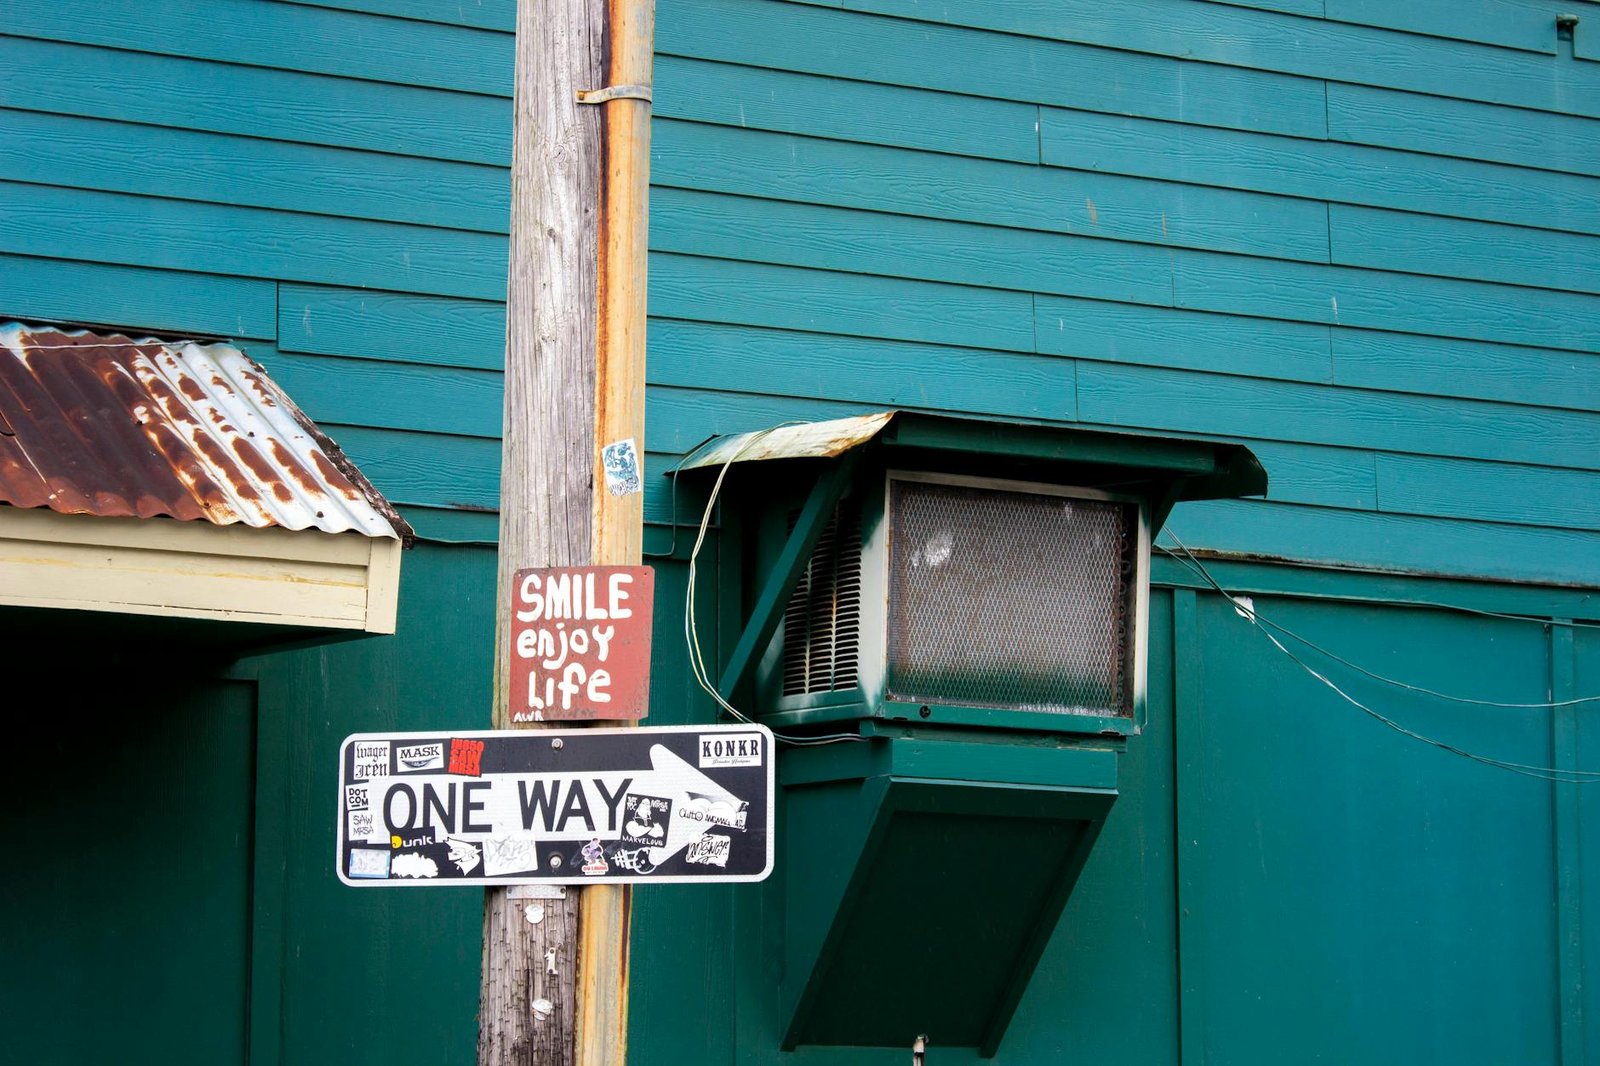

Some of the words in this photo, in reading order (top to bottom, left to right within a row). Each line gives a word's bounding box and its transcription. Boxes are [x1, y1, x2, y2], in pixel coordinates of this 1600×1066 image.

[516, 572, 634, 623] SMILE
[400, 746, 440, 759] MASK
[703, 740, 759, 757] KONKR
[349, 788, 368, 798] DOT
[349, 796, 369, 806] COM
[383, 781, 493, 834] ONE
[518, 778, 633, 832] WAY
